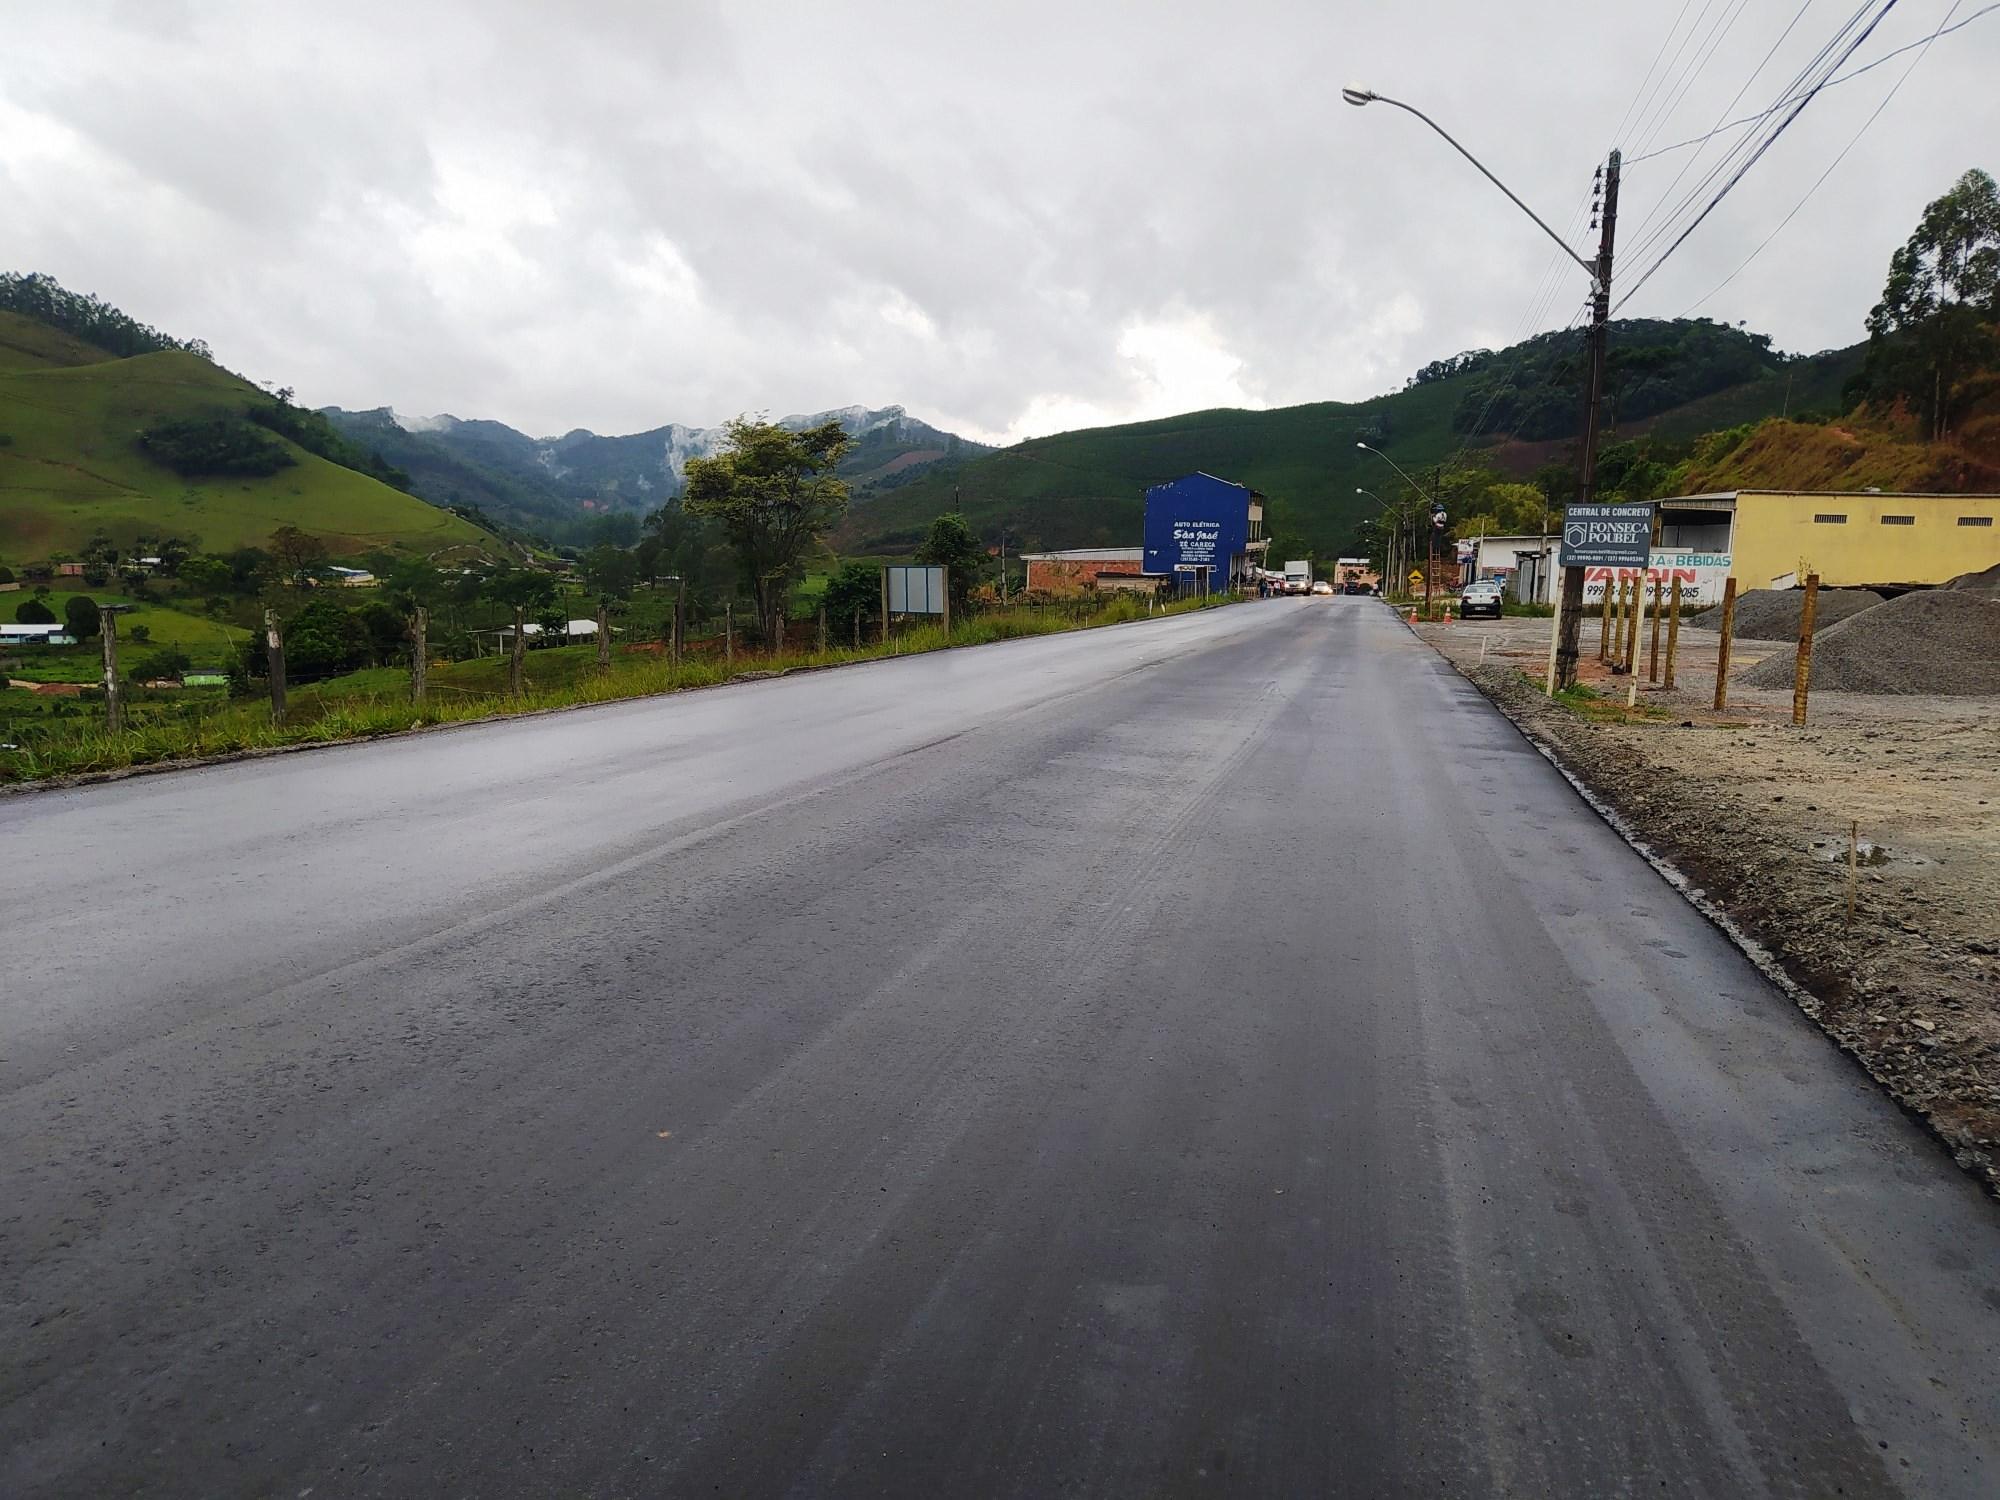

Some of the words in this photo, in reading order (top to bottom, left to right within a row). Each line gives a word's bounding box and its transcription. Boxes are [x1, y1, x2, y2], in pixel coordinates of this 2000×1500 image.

[1568, 507, 1599, 516] CENTRAL
[1600, 507, 1610, 516] DE
[1612, 507, 1650, 517] CONCRETO
[1589, 522, 1650, 533] FONSECA
[1588, 532, 1639, 544] POUBEL
[1675, 555, 1732, 567] BEBIDAS
